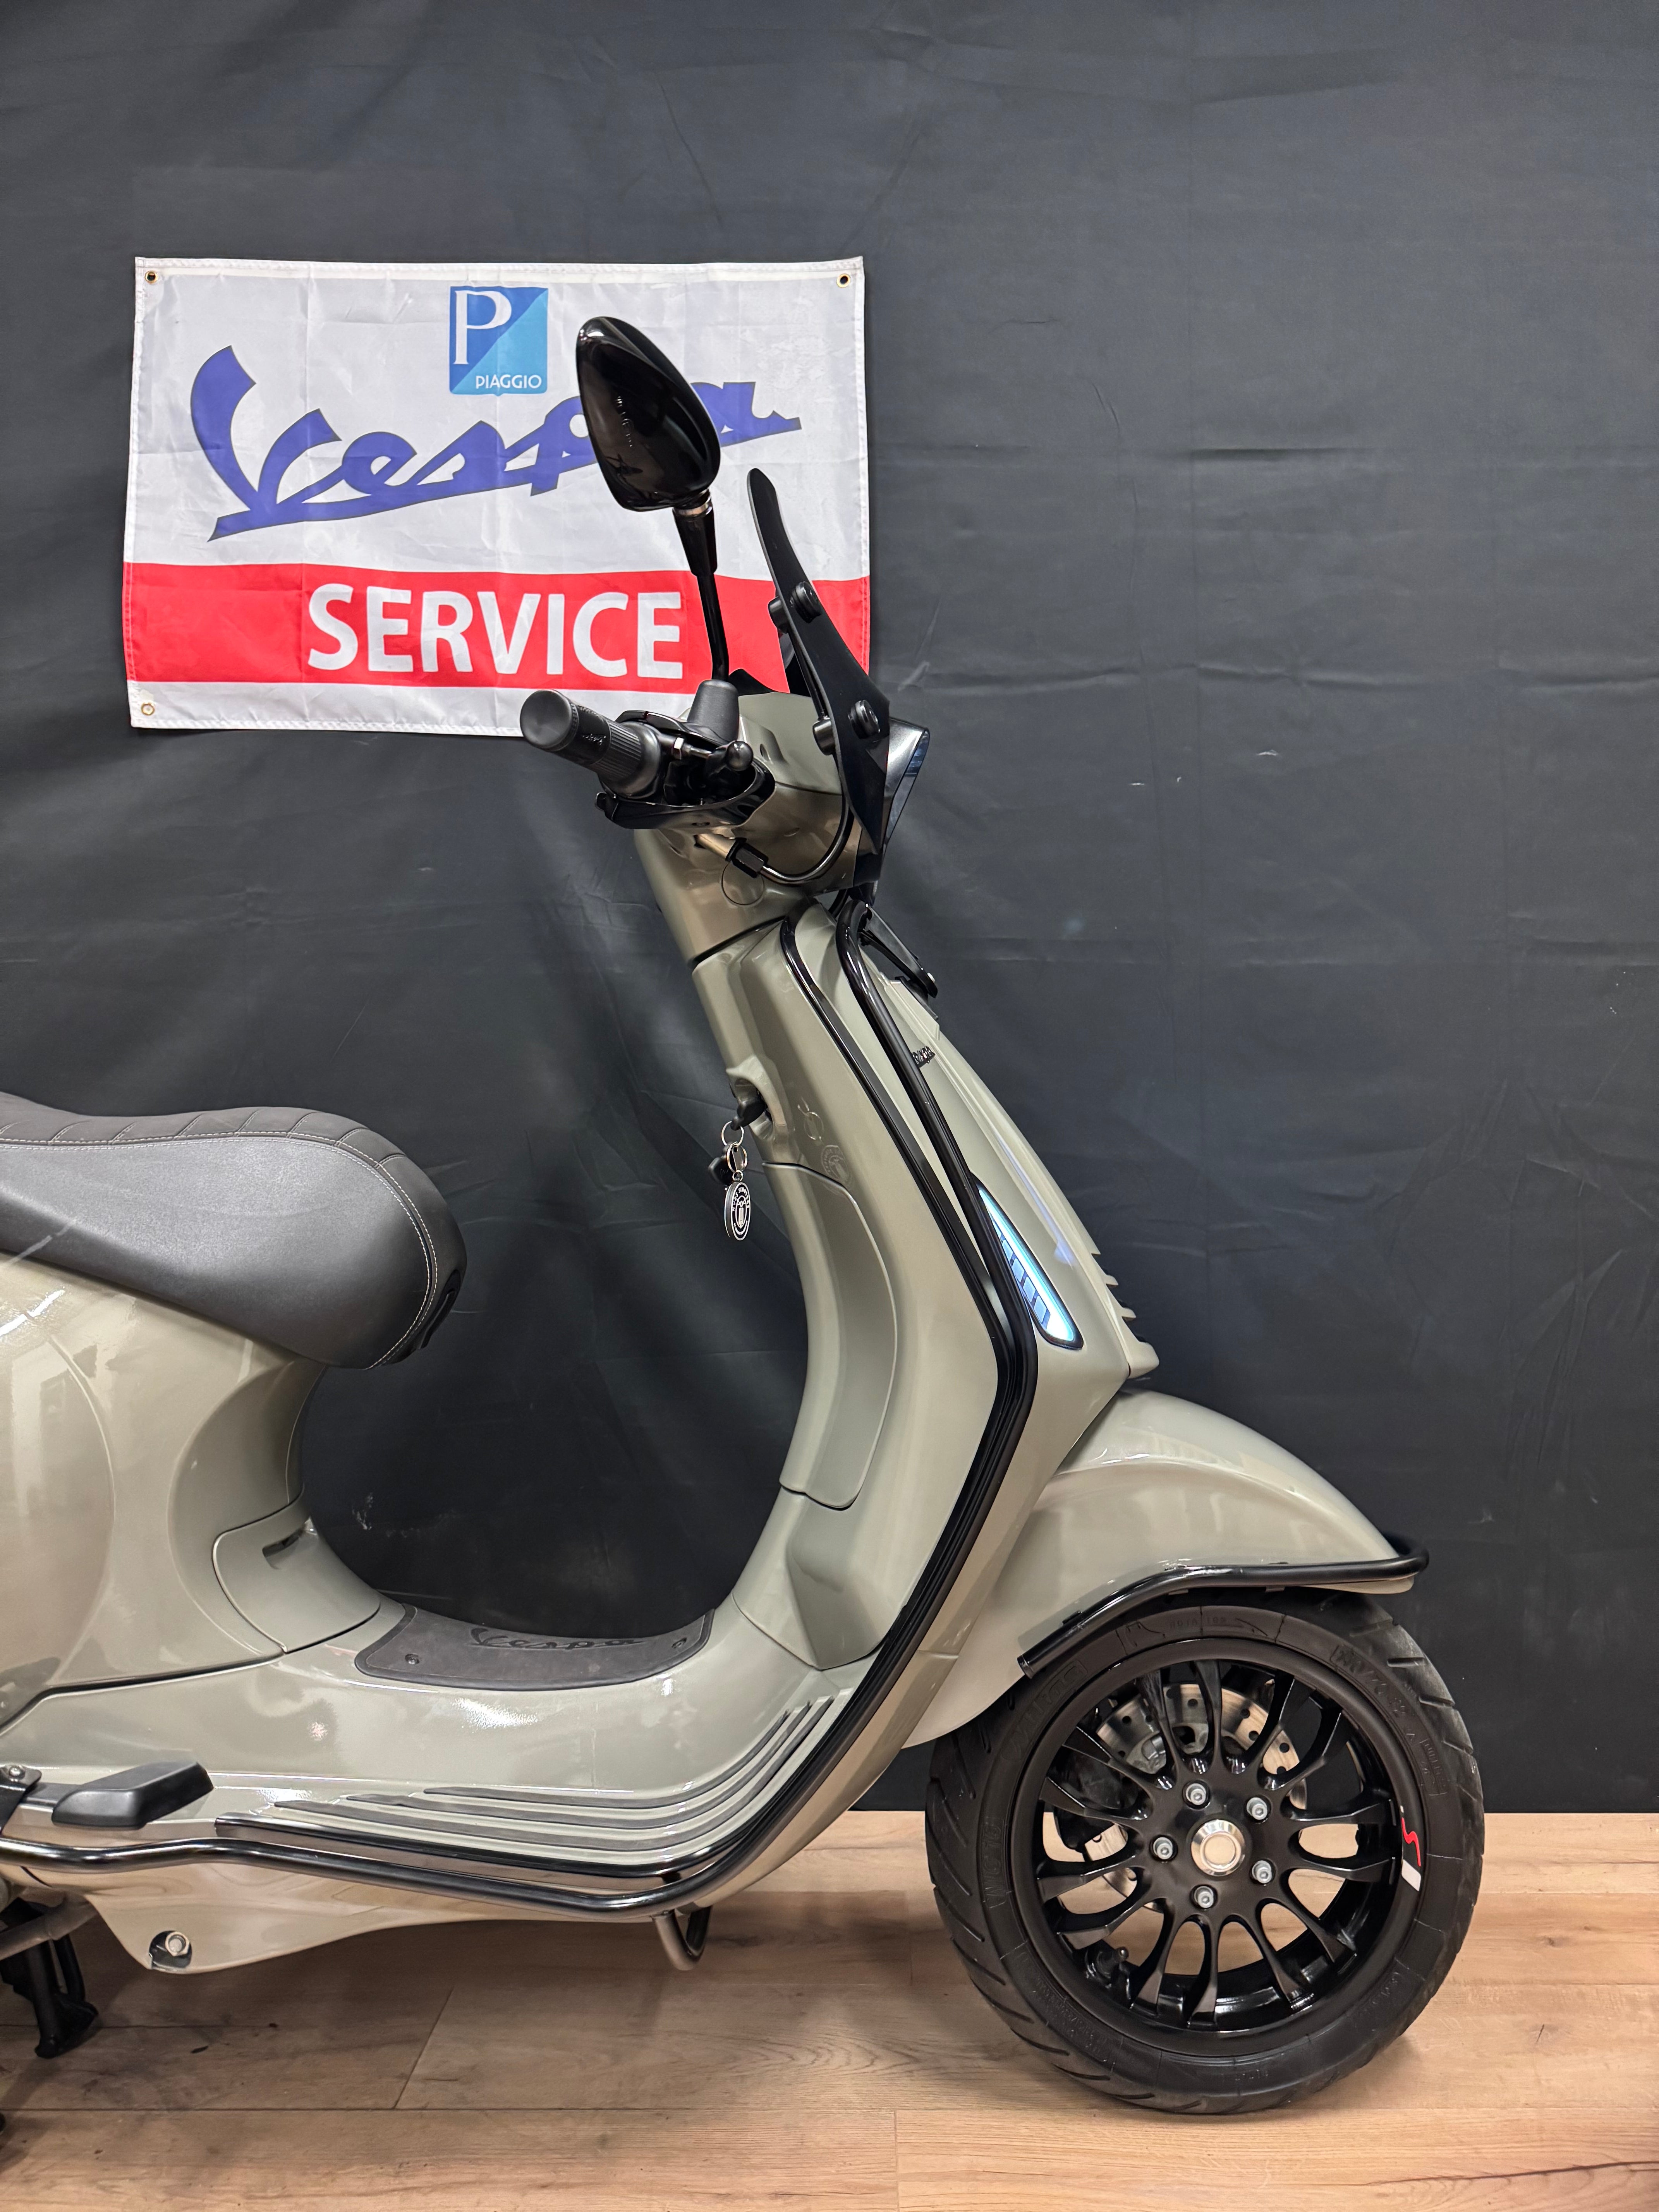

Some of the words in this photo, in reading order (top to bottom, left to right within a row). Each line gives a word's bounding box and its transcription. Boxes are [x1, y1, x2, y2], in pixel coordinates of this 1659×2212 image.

[453, 290, 512, 364] P
[476, 374, 542, 389] PIAGGIO
[308, 583, 683, 678] SERVICE
[467, 1628, 646, 1650] Vespa
